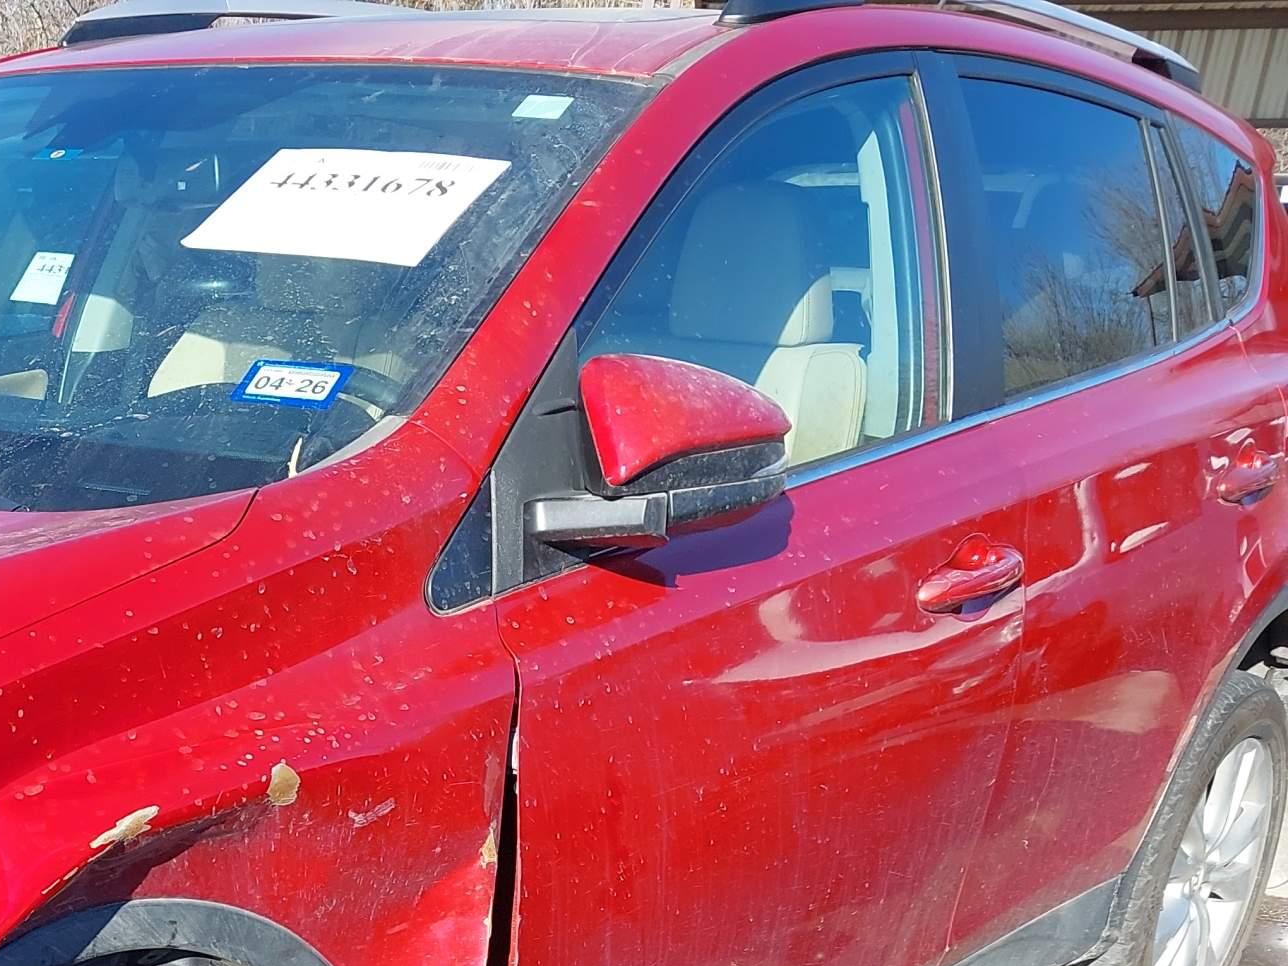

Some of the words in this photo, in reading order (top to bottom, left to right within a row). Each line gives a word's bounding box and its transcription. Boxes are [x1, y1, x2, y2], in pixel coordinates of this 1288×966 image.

[270, 171, 455, 198] 44331678
[254, 376, 285, 391] 04
[295, 378, 328, 395] 26
